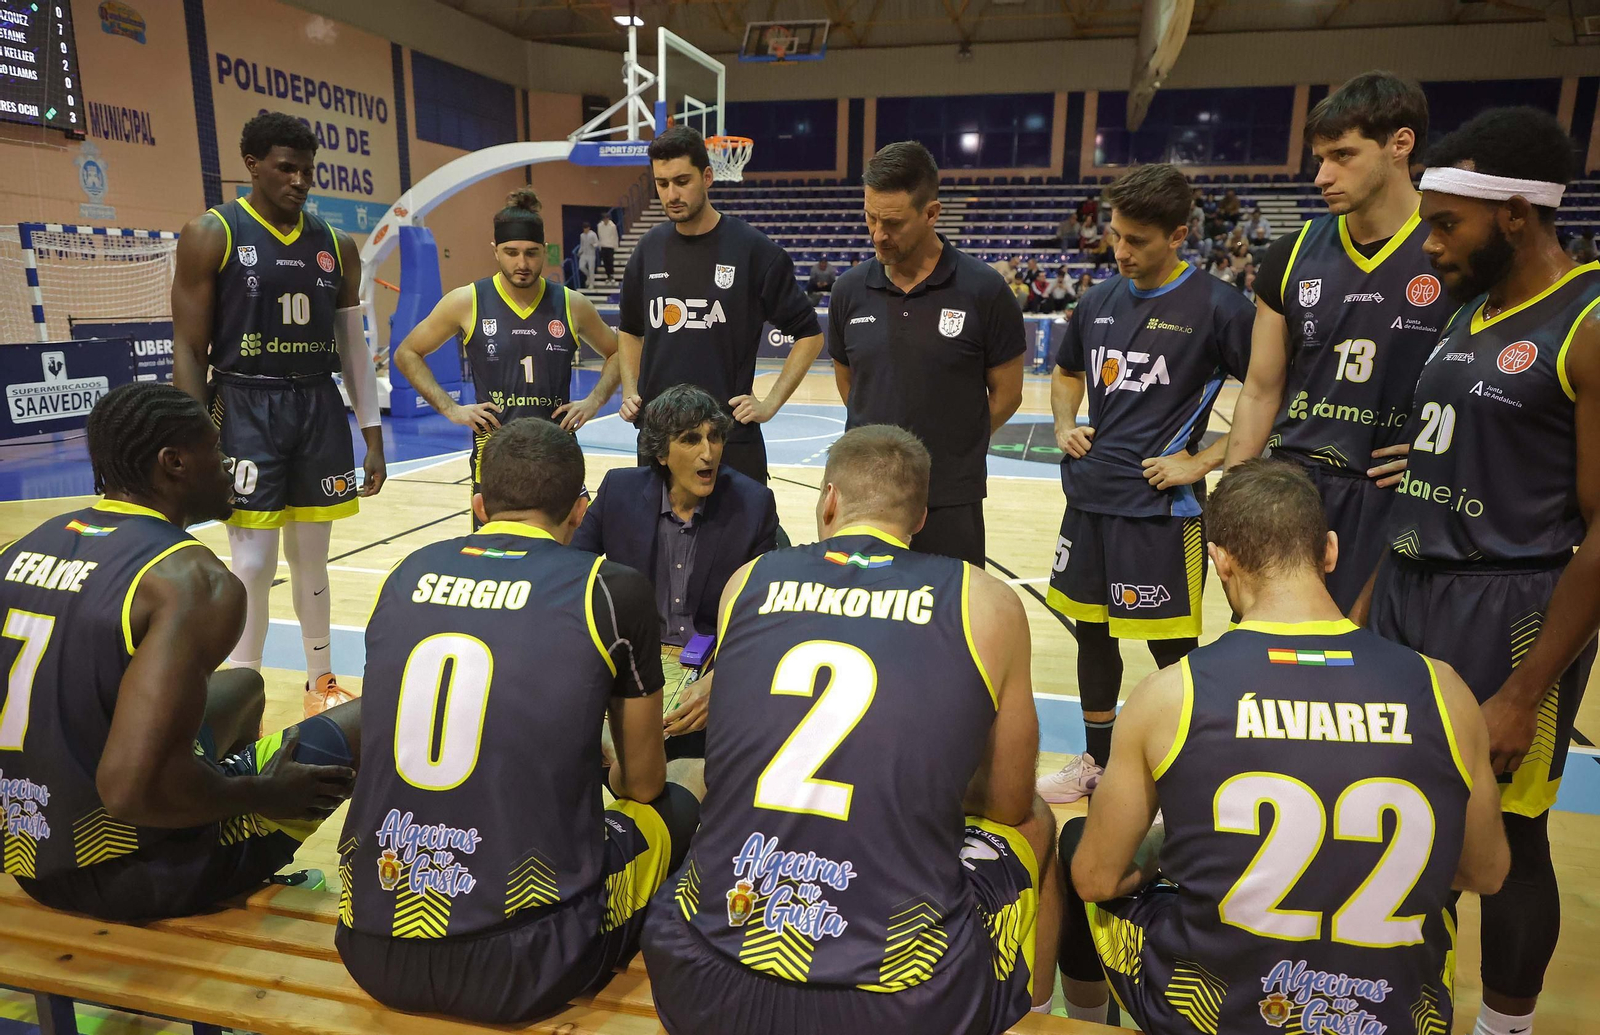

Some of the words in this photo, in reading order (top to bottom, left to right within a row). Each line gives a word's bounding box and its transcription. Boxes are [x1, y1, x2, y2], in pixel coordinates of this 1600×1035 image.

[4, 46, 36, 63] KELLIER
[62, 60, 70, 71] 2
[60, 42, 67, 54] 0
[9, 66, 38, 81] LLAMAS
[64, 77, 72, 88] 0
[216, 53, 388, 124] POLIDEPORTIVO
[18, 103, 39, 117] OCHI
[70, 112, 76, 123] 3
[67, 94, 74, 106] 0
[88, 101, 155, 146] MUNICIPAL
[346, 127, 370, 156] DE
[311, 162, 374, 196] CIRAS
[278, 292, 310, 325] 10
[650, 296, 726, 333] UDEA
[1158, 321, 1192, 334] damex.io
[520, 356, 534, 384] 1
[1091, 346, 1170, 396] UDEA
[1334, 338, 1376, 384] 13
[12, 381, 102, 396] SUPERMERCADOS
[1486, 385, 1503, 394] Junta
[1491, 394, 1522, 408] Andalucía
[1414, 402, 1456, 454] 20
[412, 572, 531, 610] SERGIO
[758, 581, 934, 625] JANKOVIĆ
[0, 608, 56, 752] 7
[394, 632, 494, 792] 0
[754, 640, 878, 821] 2
[1236, 692, 1413, 744] ÁLVAREZ
[8, 803, 50, 841] Gusta
[376, 808, 482, 863] Algeciras
[408, 854, 476, 897] Gusta
[434, 851, 454, 868] me
[732, 832, 857, 895] Algeciras
[1213, 770, 1436, 949] 22
[798, 883, 822, 904] me
[764, 885, 848, 940] Gusta
[1261, 960, 1393, 1004] Algeciras
[1301, 998, 1388, 1035] Gusta
[1332, 998, 1359, 1013] me
